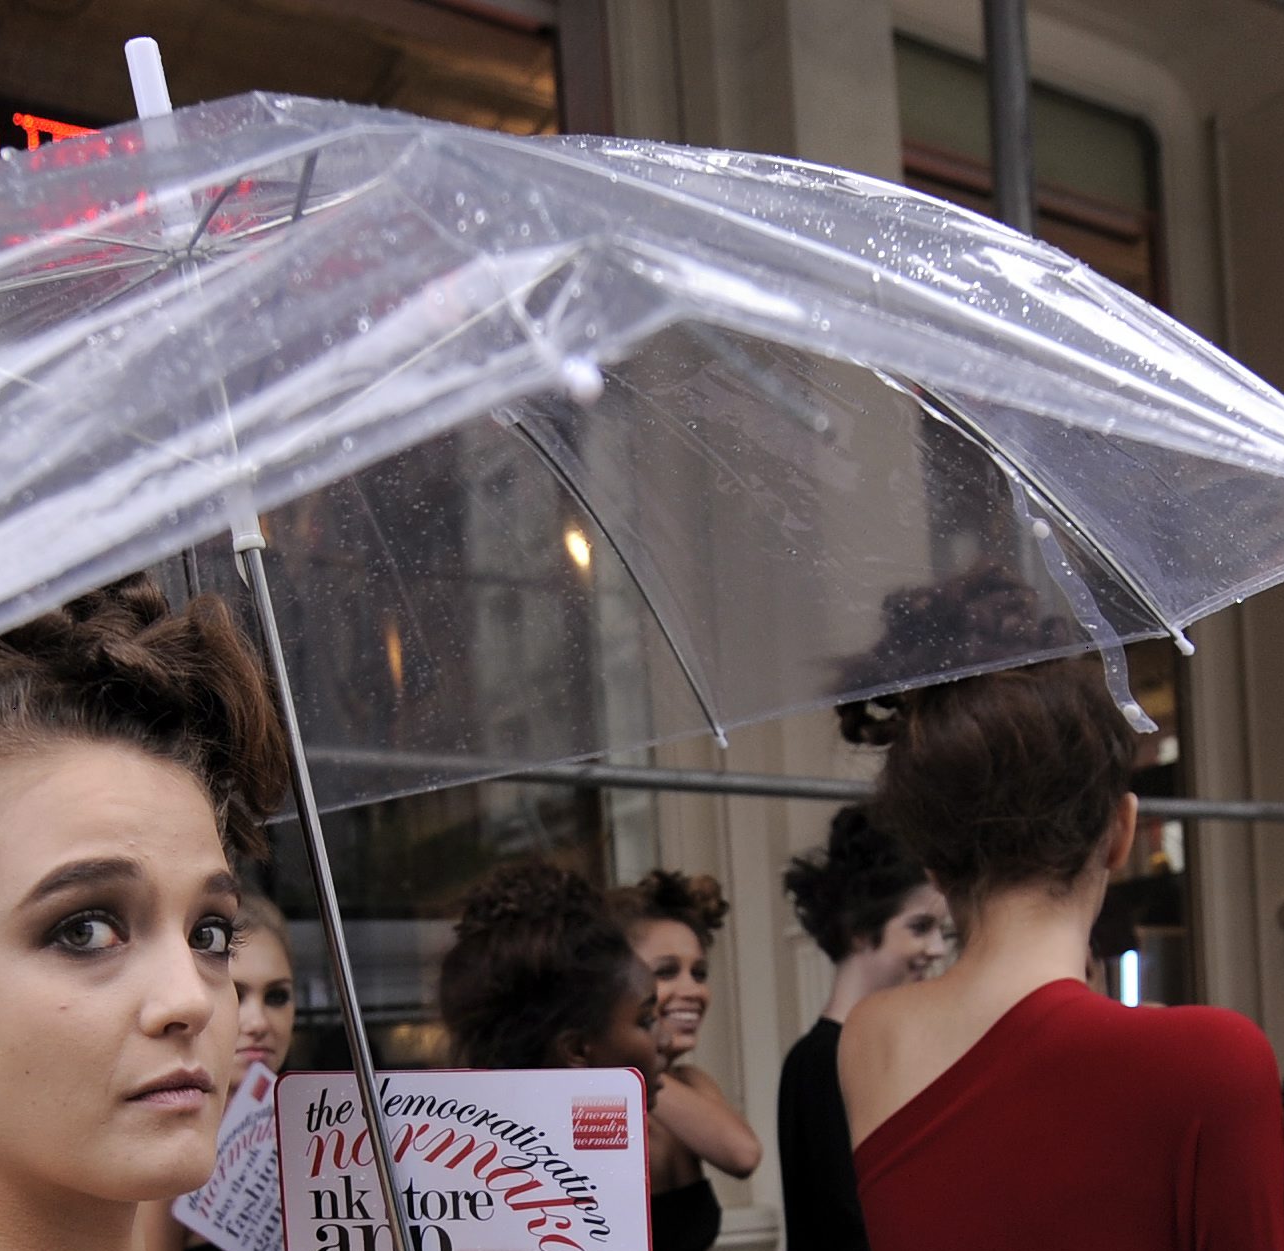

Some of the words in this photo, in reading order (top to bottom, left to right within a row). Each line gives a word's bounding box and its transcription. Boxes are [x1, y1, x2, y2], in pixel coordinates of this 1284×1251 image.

[306, 1087, 354, 1133] the
[308, 1175, 375, 1221] nk
[385, 1177, 495, 1222] tore
